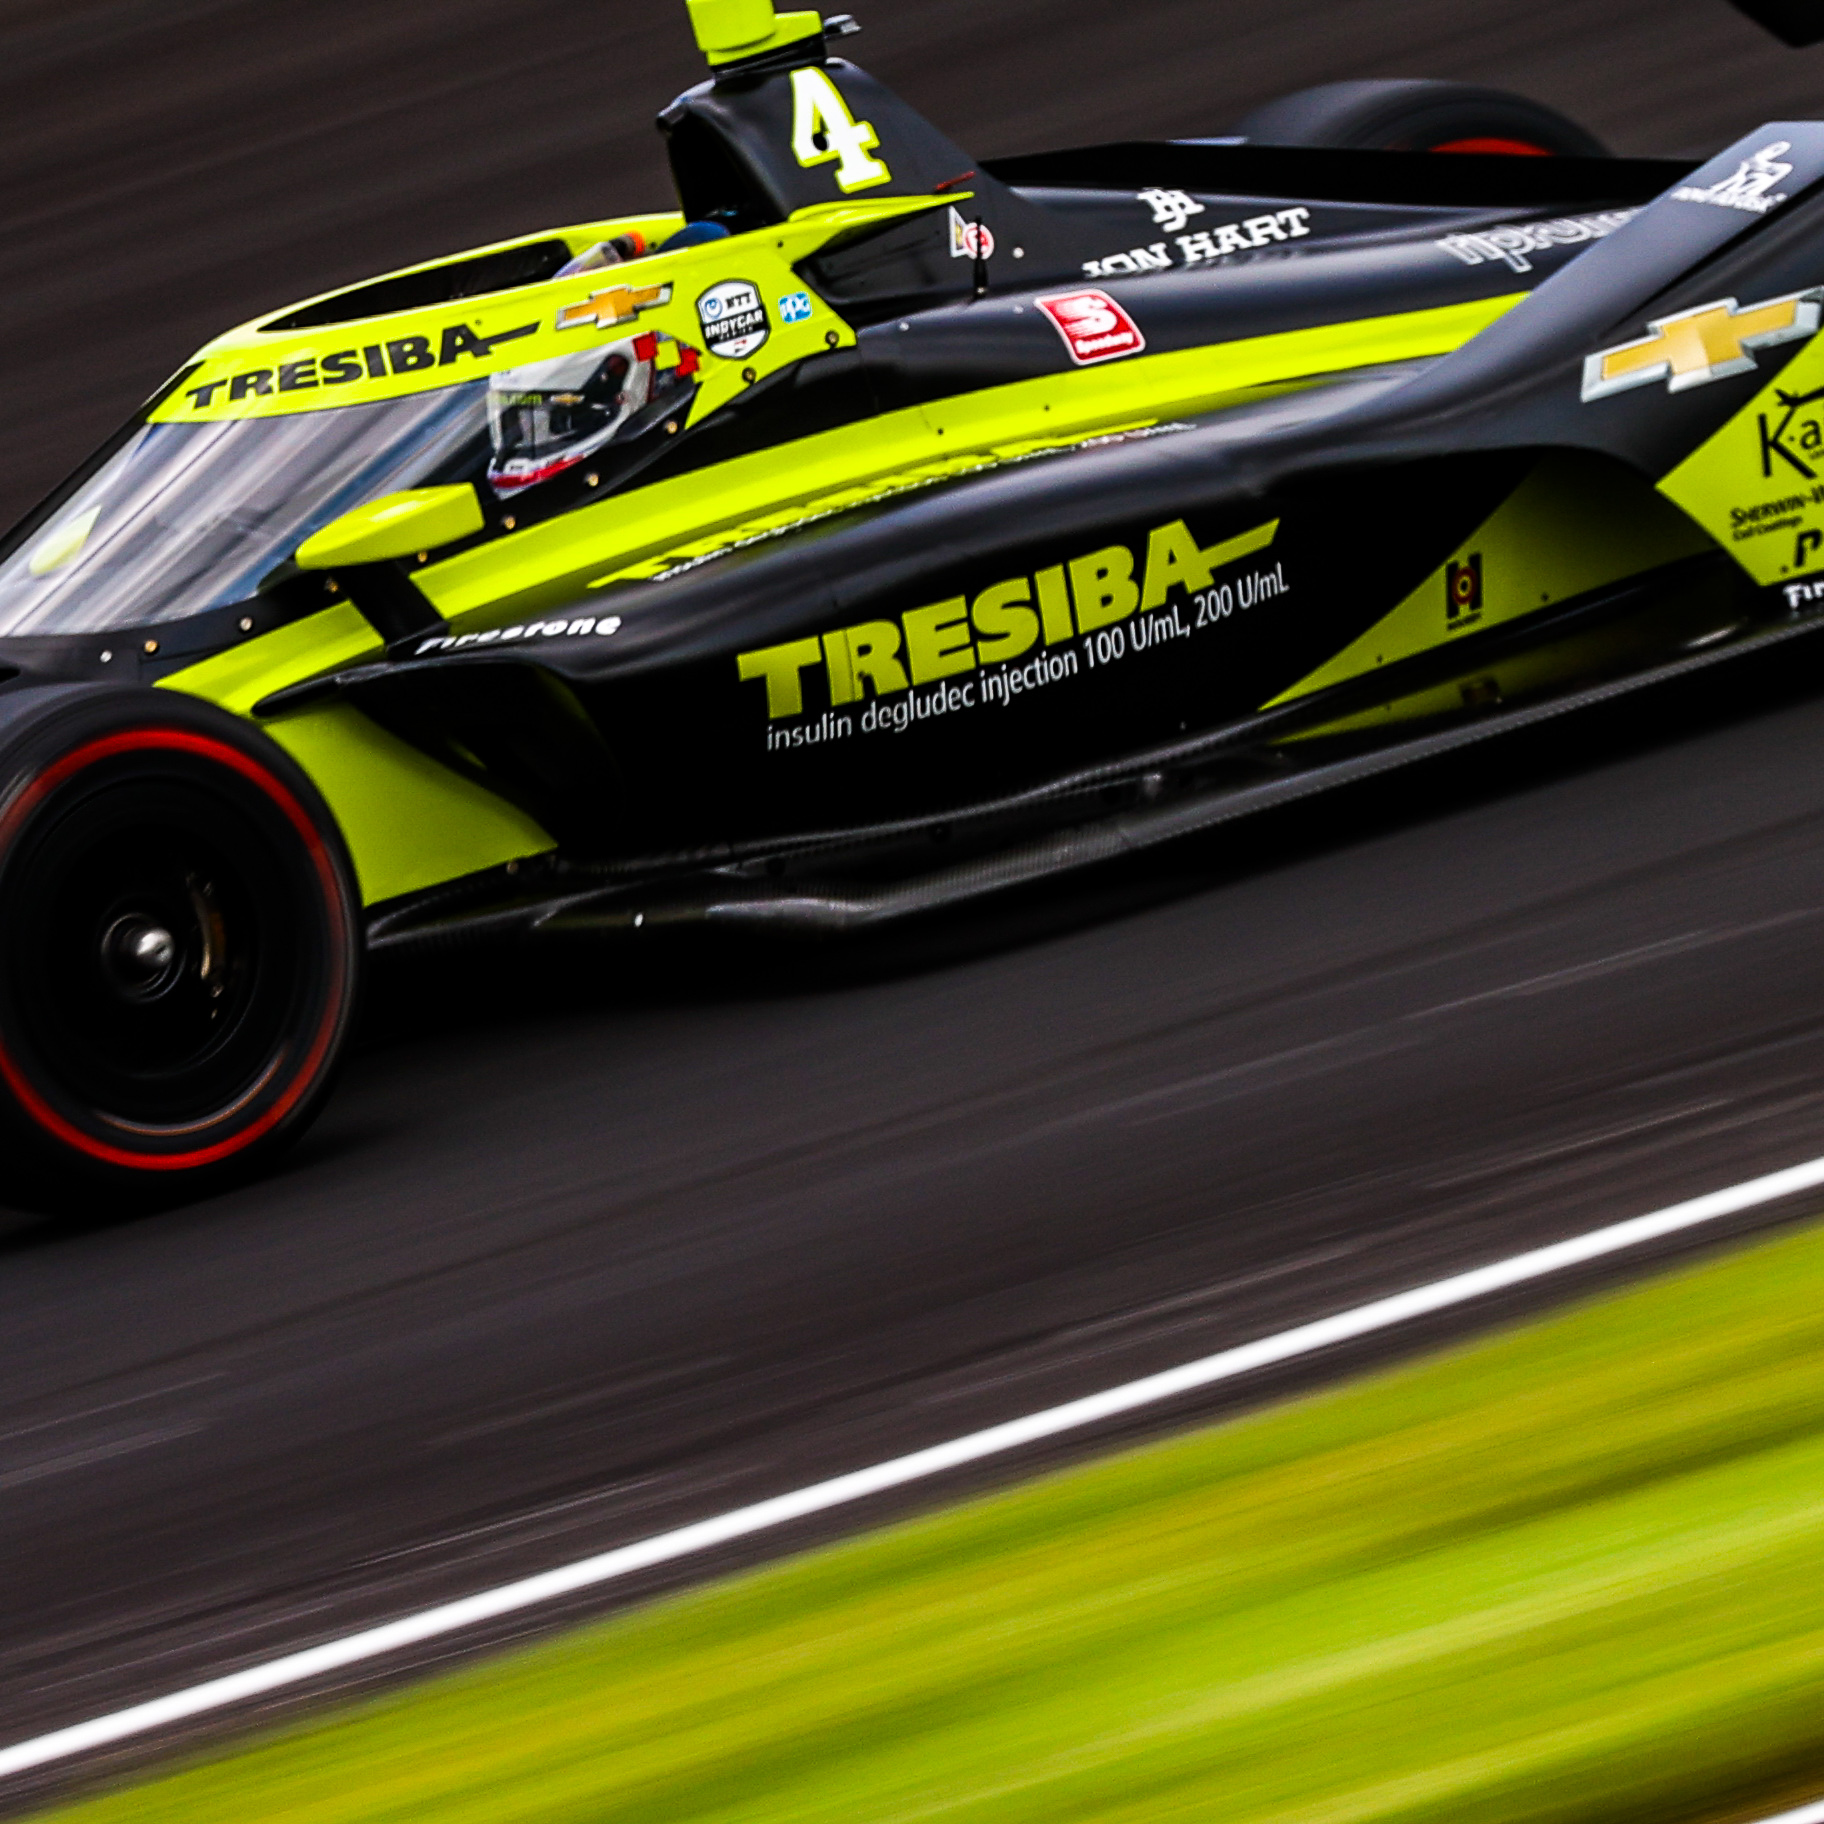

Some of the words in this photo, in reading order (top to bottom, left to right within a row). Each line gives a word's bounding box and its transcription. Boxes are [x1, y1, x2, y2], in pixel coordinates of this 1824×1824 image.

[789, 65, 892, 194] 4
[1082, 243, 1173, 277] JON
[1176, 207, 1311, 263] HART
[704, 309, 764, 339] INDYCAR
[725, 292, 751, 310] NTT
[186, 321, 540, 410] TRESIBA
[736, 518, 1280, 720] TRESIBA
[766, 712, 853, 752] insulin
[860, 681, 976, 733] degludec
[979, 650, 1078, 707] injection
[1083, 625, 1126, 669] 100
[1129, 603, 1191, 653] U/mL,
[1193, 584, 1234, 629] 200
[1236, 561, 1290, 610] U/mL
